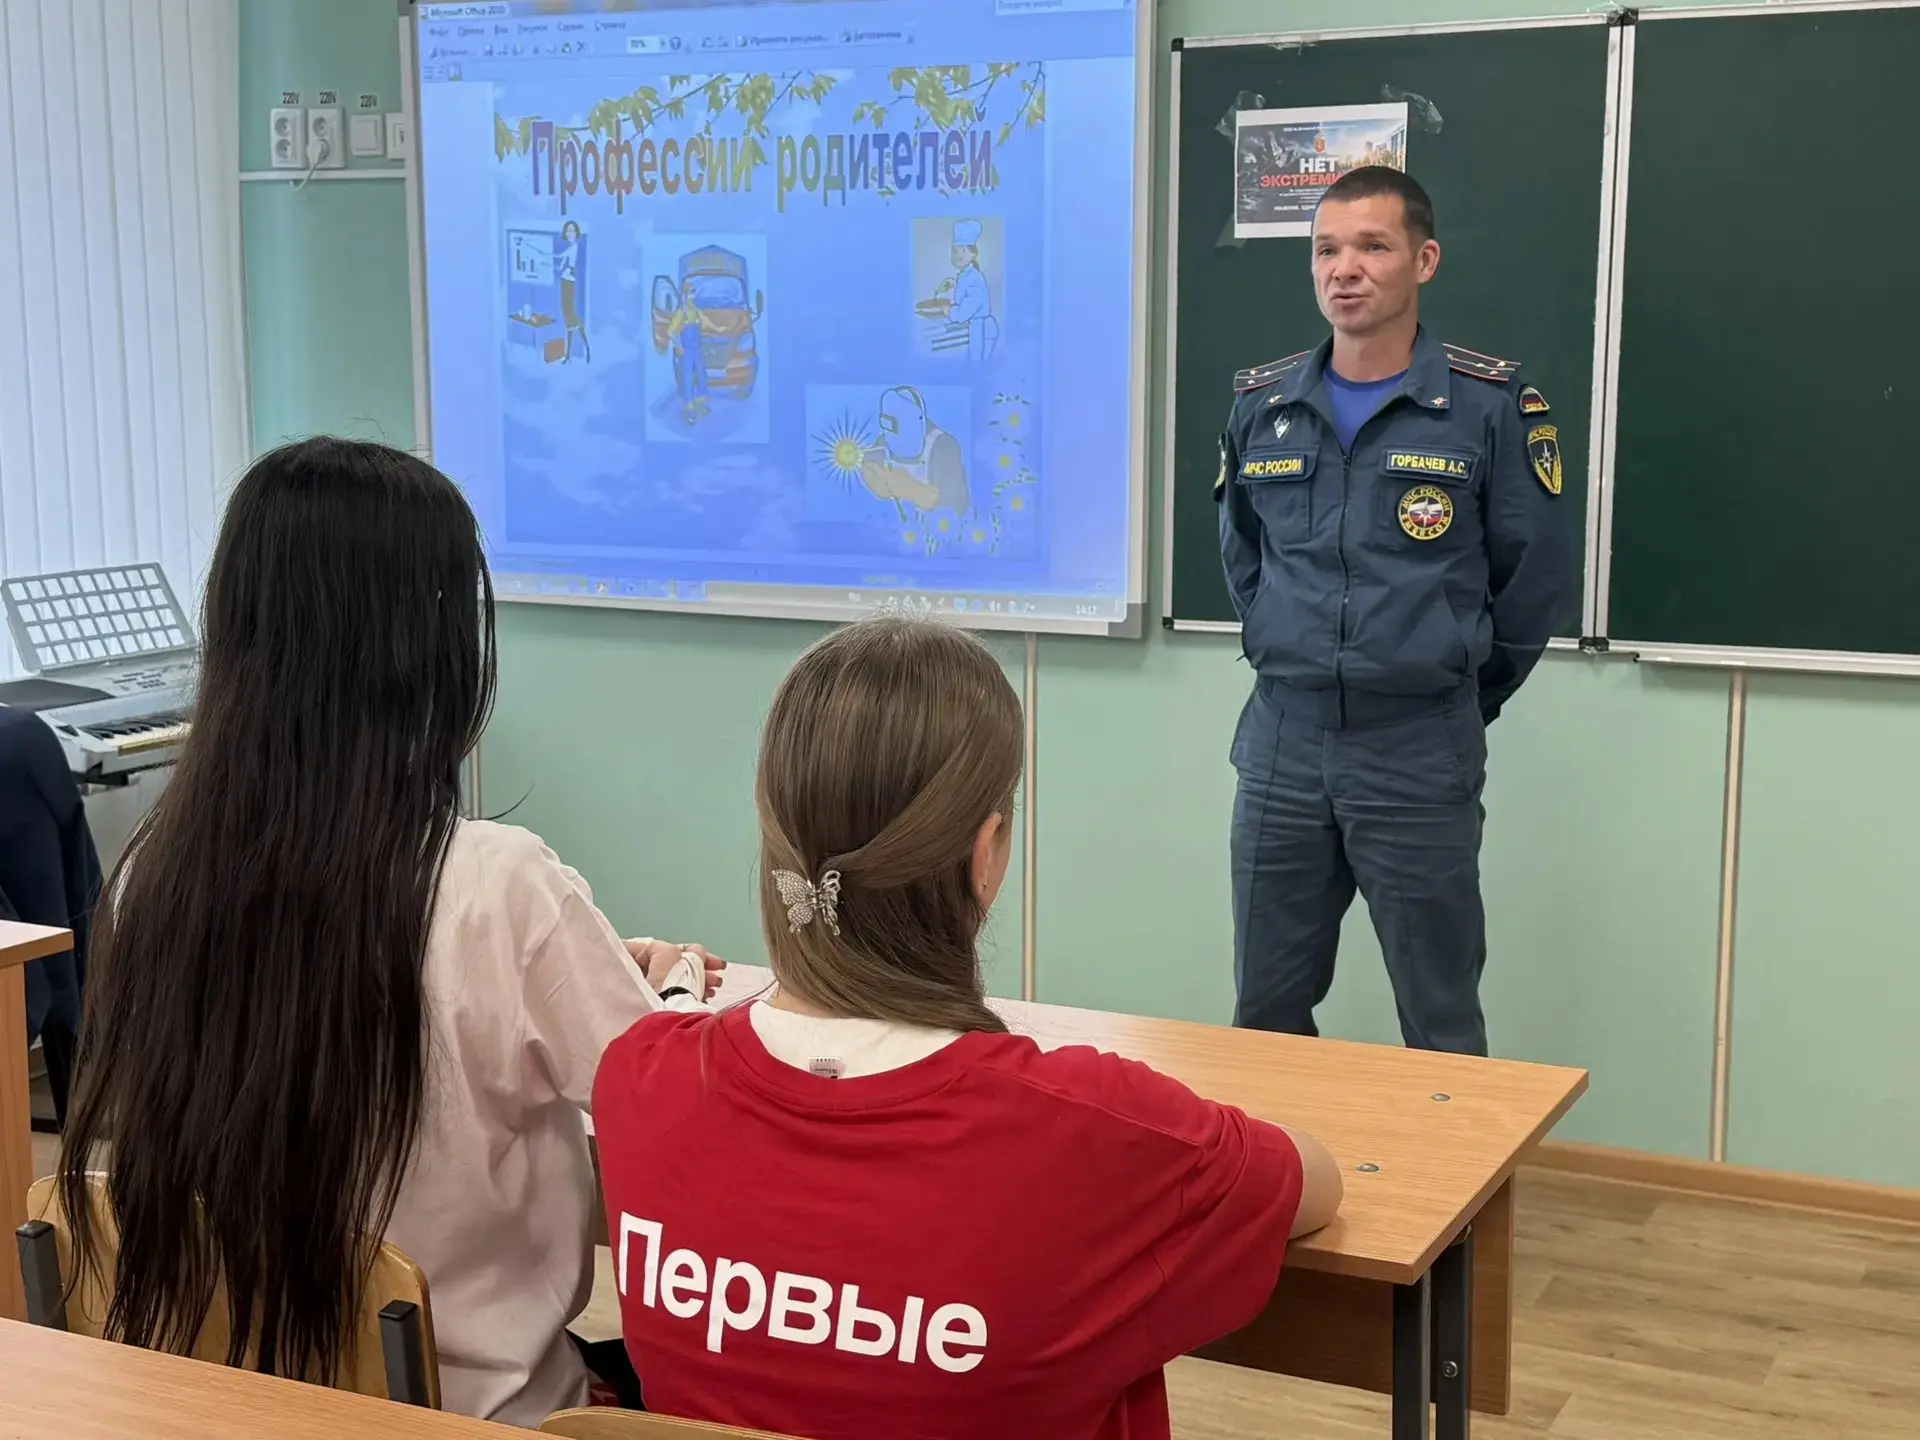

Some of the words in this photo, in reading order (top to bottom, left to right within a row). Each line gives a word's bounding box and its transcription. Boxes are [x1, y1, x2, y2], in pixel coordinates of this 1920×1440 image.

[430, 8, 463, 17] Microsoft
[465, 8, 486, 16] Office
[532, 119, 752, 215] Профессии
[776, 106, 991, 213] родителей
[1300, 157, 1339, 174] НЕТ
[1260, 172, 1345, 188] ЭКСТРЕМИ
[1243, 460, 1264, 475] МЧС
[1265, 458, 1301, 474] РОССИИ
[1390, 454, 1445, 471] ГОРБАЧЕВ
[1402, 491, 1417, 510] МЧС
[618, 1211, 988, 1373] Первые
